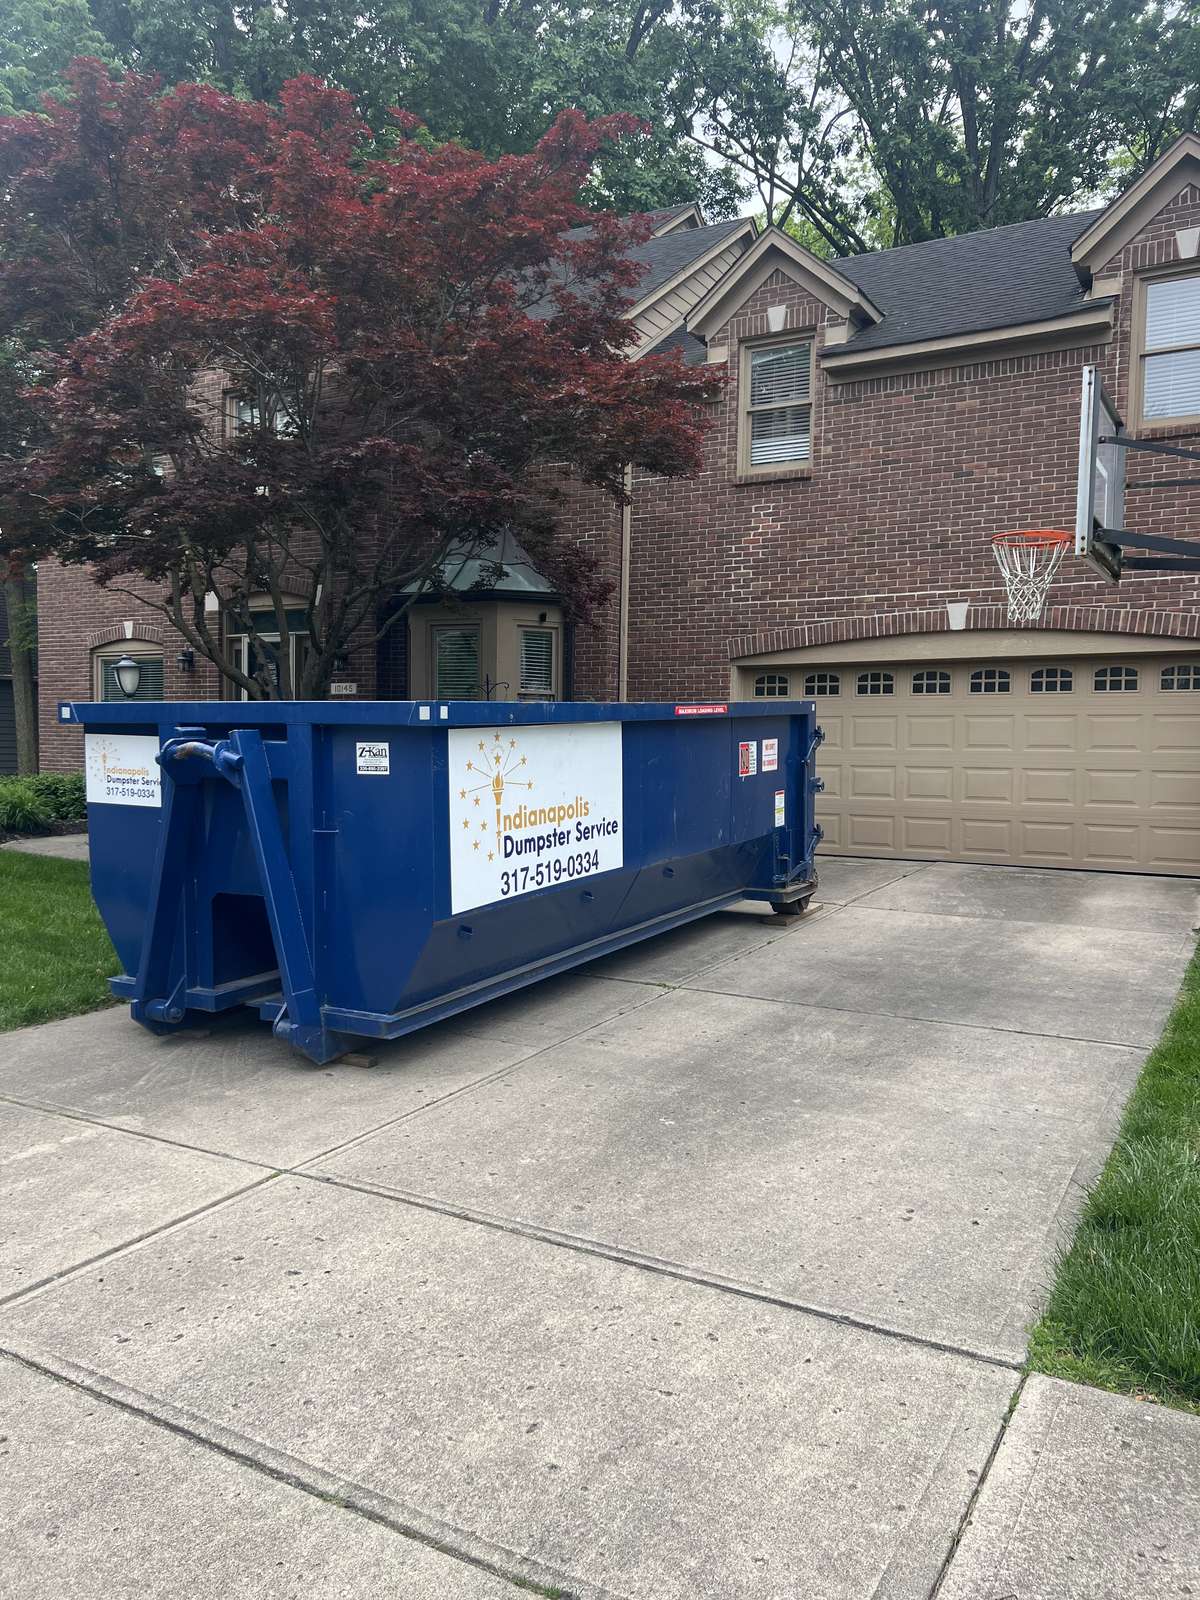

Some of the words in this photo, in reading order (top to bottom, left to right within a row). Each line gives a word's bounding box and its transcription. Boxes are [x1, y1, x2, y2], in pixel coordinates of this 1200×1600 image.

[334, 685, 353, 693] 10145
[106, 775, 140, 785] Dumpster
[106, 787, 155, 798] 317-519-0334
[503, 827, 571, 859] Dumpster
[575, 817, 619, 842] Service
[500, 849, 600, 896] 317-519-0334
